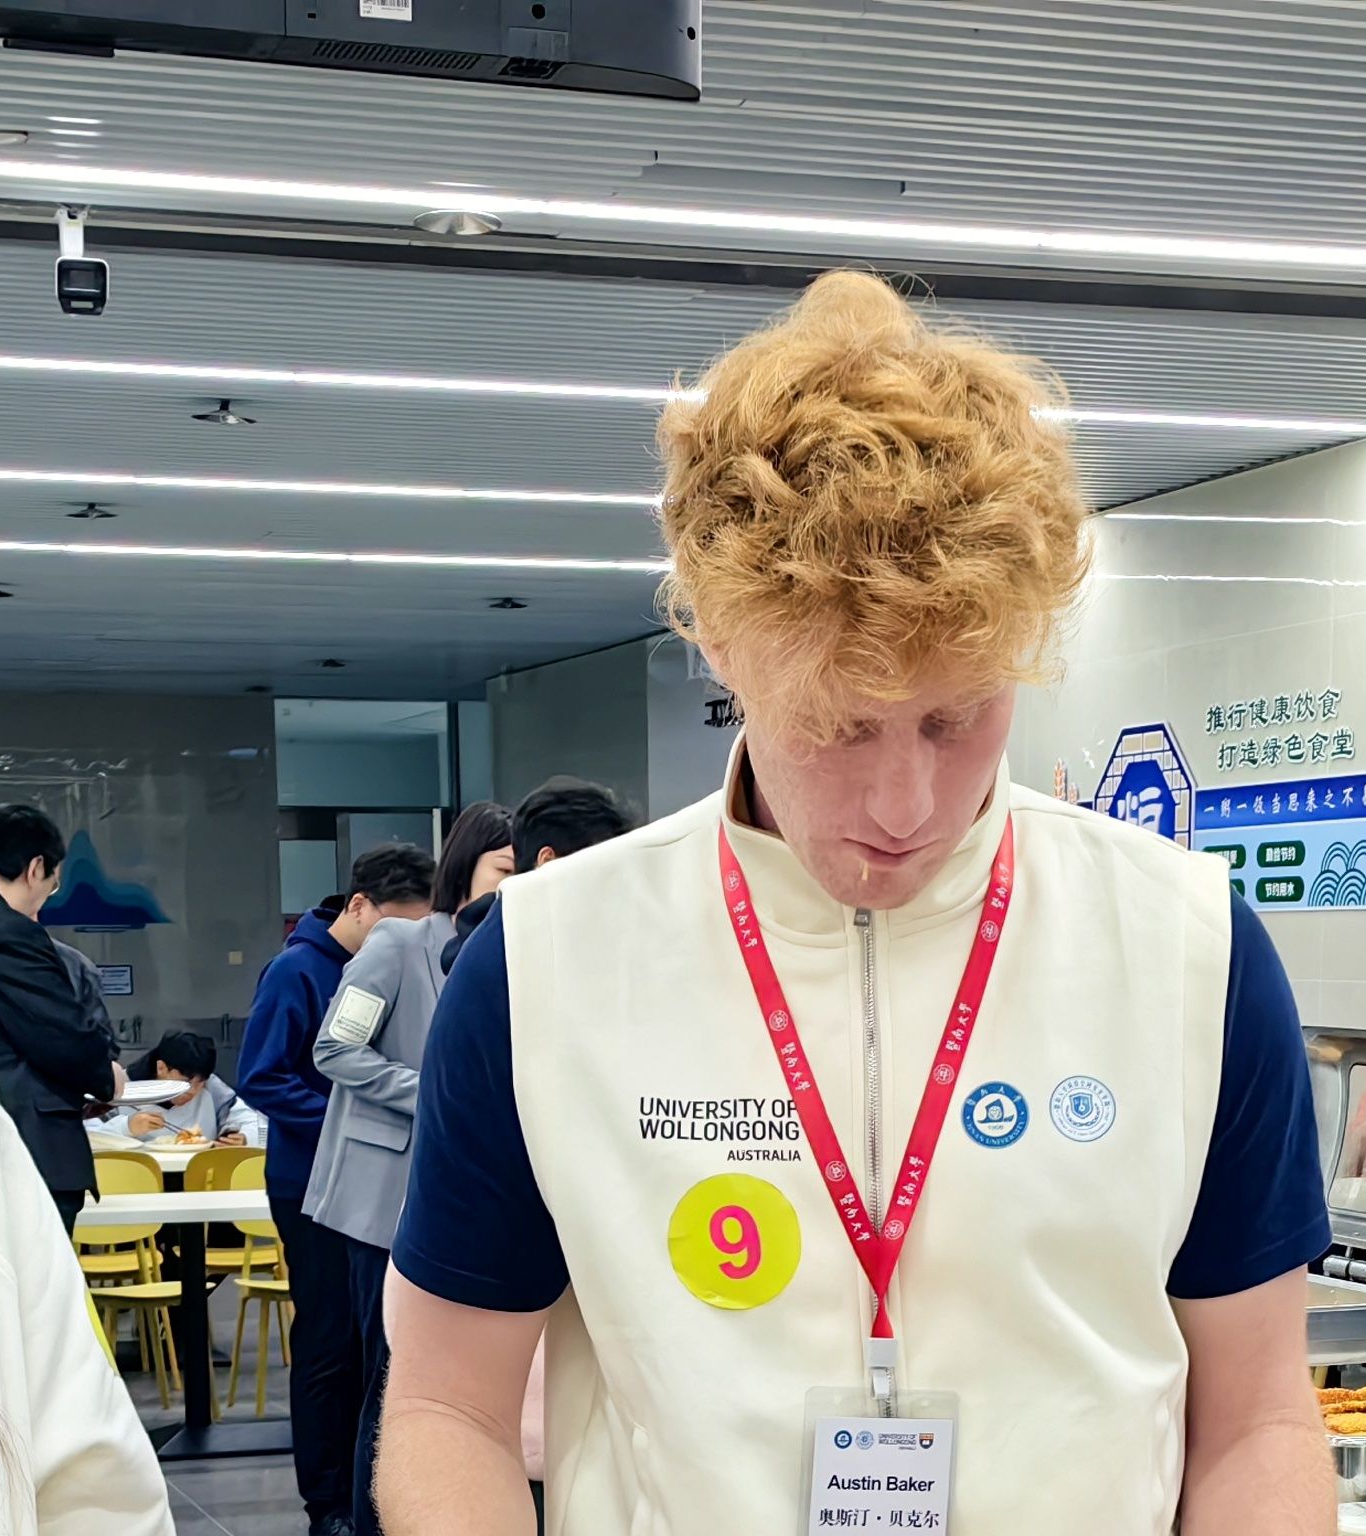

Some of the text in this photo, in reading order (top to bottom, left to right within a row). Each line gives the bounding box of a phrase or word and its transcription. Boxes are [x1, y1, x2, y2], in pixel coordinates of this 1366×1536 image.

[1206, 688, 1341, 733] 推行健康饮食
[1217, 729, 1354, 771] 打造绿色食堂
[639, 1096, 797, 1120] UNIVERSITY OF
[639, 1118, 800, 1142] WOLLONGONG
[726, 1149, 802, 1162] AUSTRALIA
[709, 1204, 762, 1280] 9
[827, 1474, 935, 1492] Austin Baker
[819, 1508, 940, 1529] 奥斯汀·贝克尔
